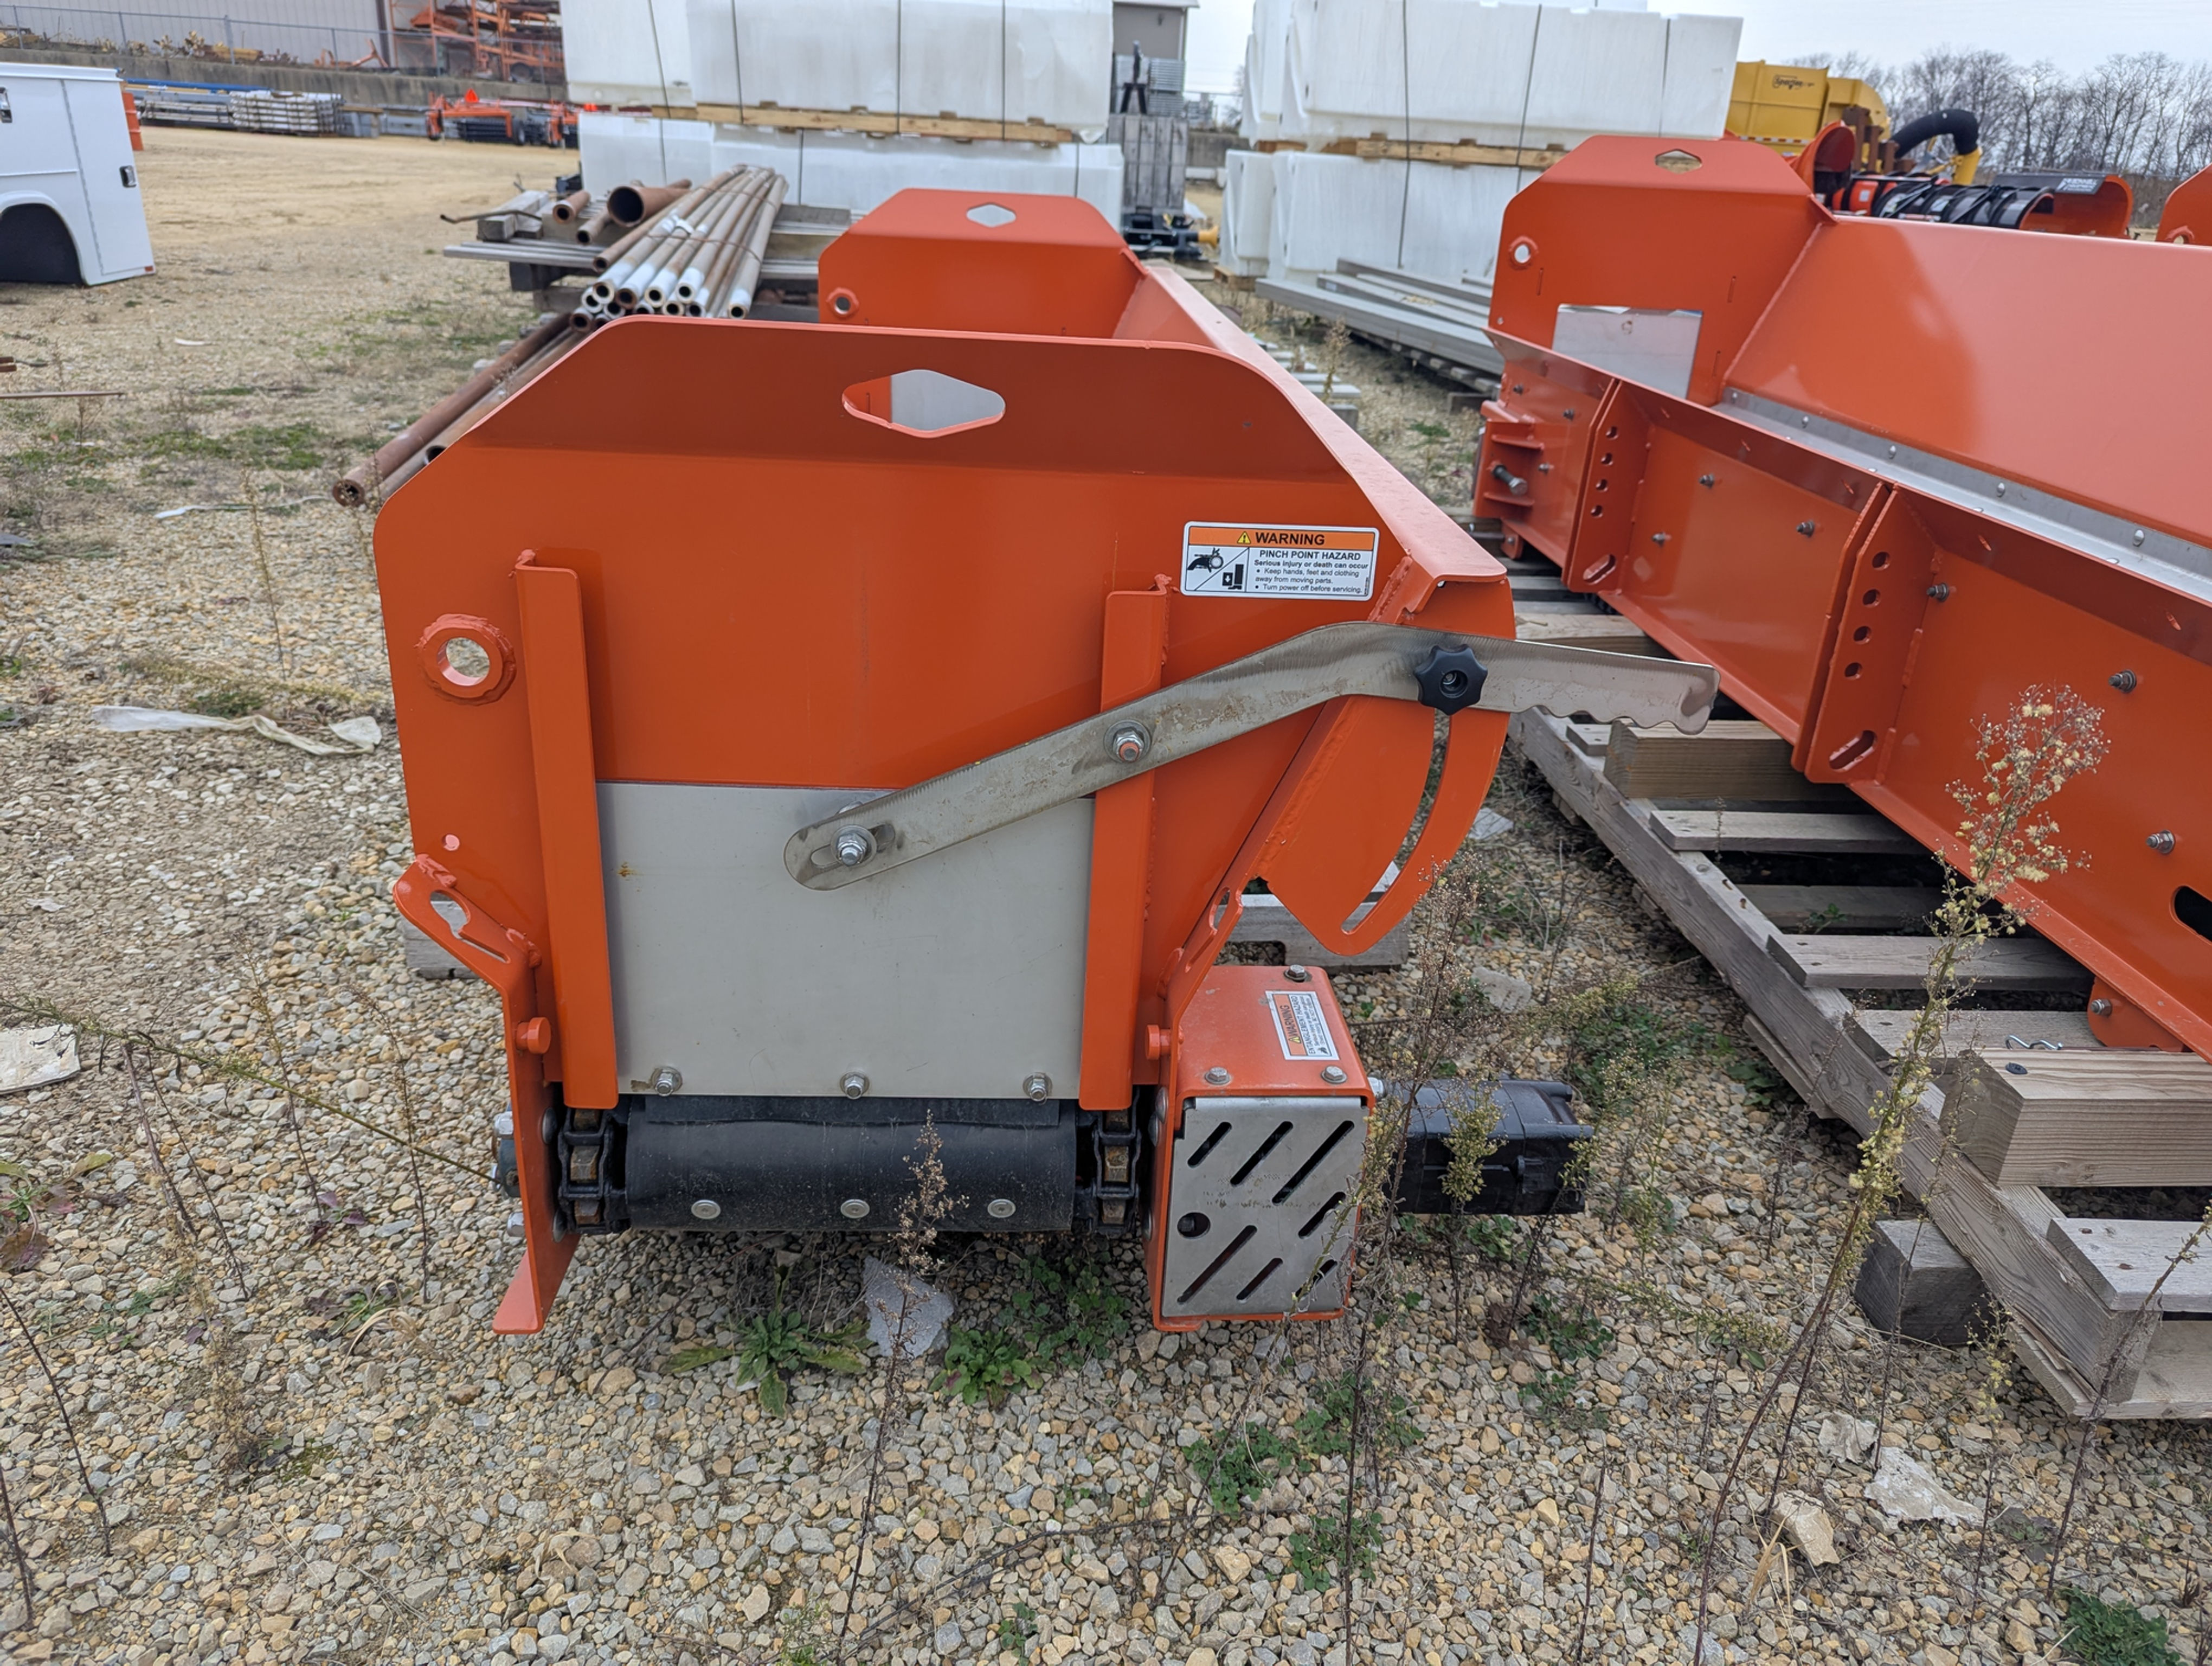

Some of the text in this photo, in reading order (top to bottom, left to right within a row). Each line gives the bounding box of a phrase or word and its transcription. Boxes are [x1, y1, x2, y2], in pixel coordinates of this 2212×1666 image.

[1255, 532, 1325, 546] WARNING
[1259, 550, 1361, 560] PINCH POINT HAZARD
[1290, 996, 1302, 1015] HAZARD
[1279, 1004, 1298, 1037] WARNING
[1297, 1016, 1316, 1054] ENTANGLEMENT
